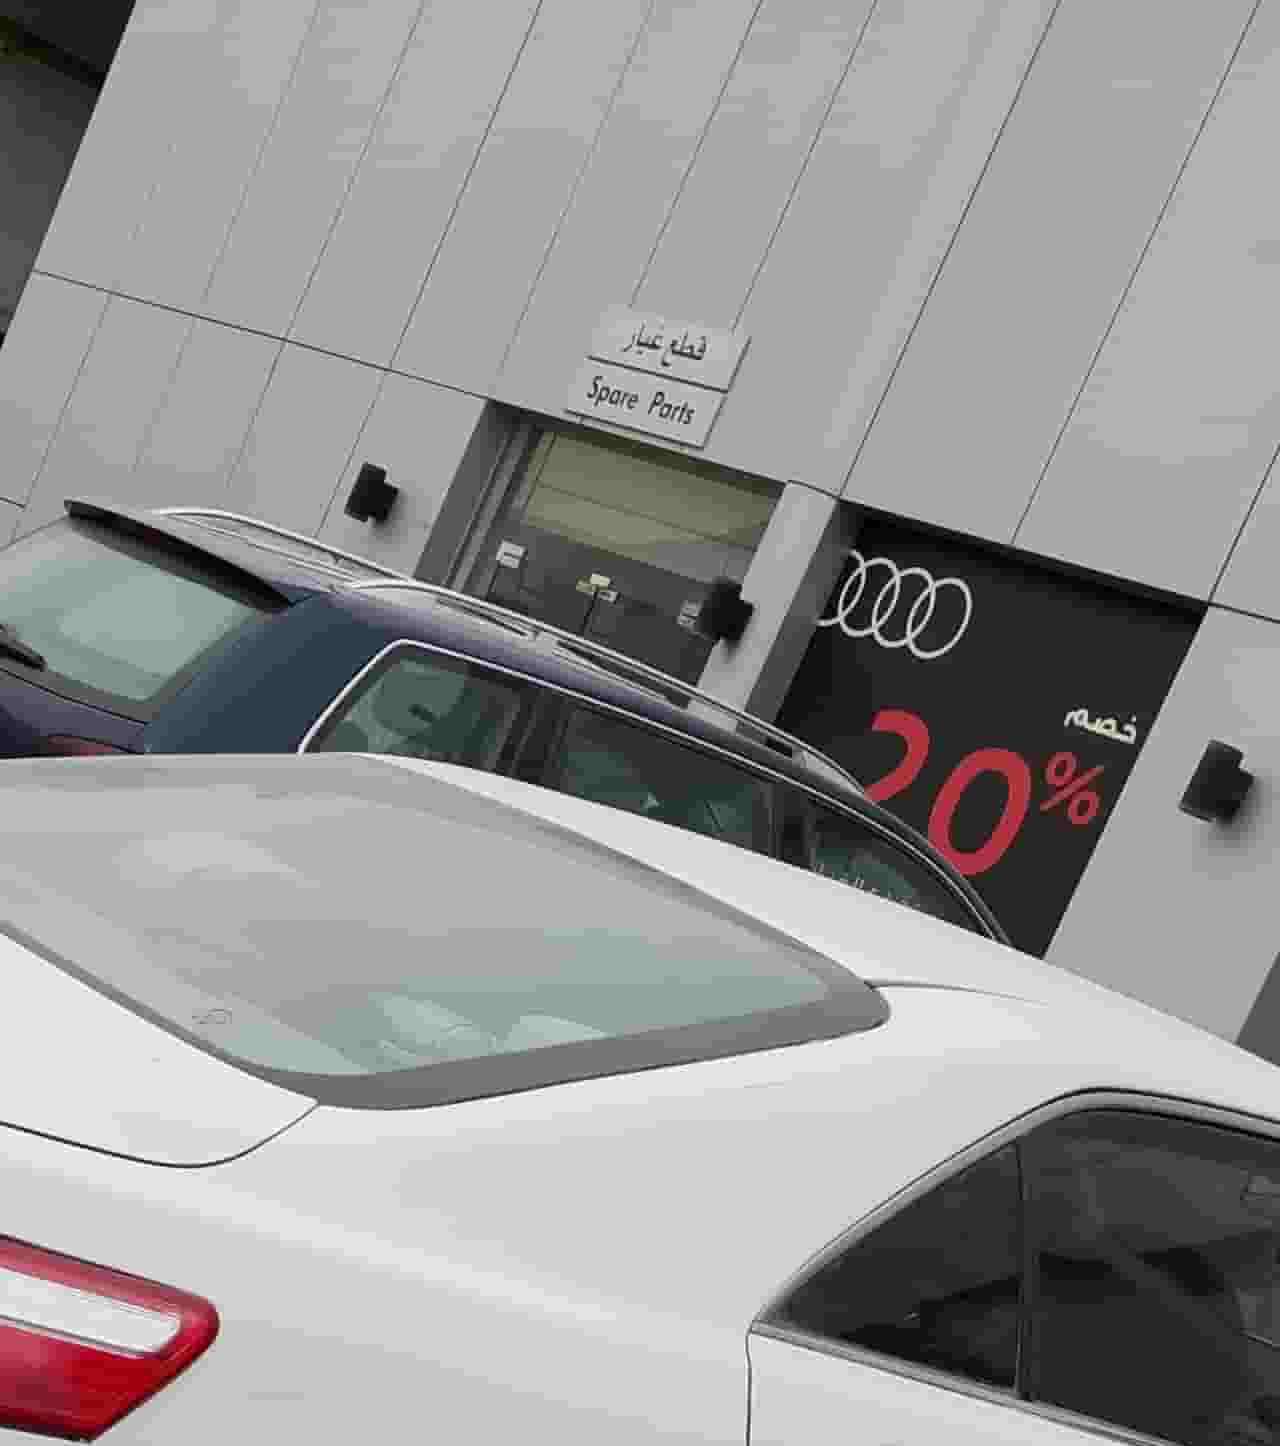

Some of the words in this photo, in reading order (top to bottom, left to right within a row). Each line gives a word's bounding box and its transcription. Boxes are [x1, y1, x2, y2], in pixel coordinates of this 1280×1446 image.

[621, 319, 663, 356] غيار
[660, 329, 708, 368] قطع
[586, 375, 639, 409] Spare
[647, 391, 695, 424] Parts
[1063, 707, 1138, 745] خصم
